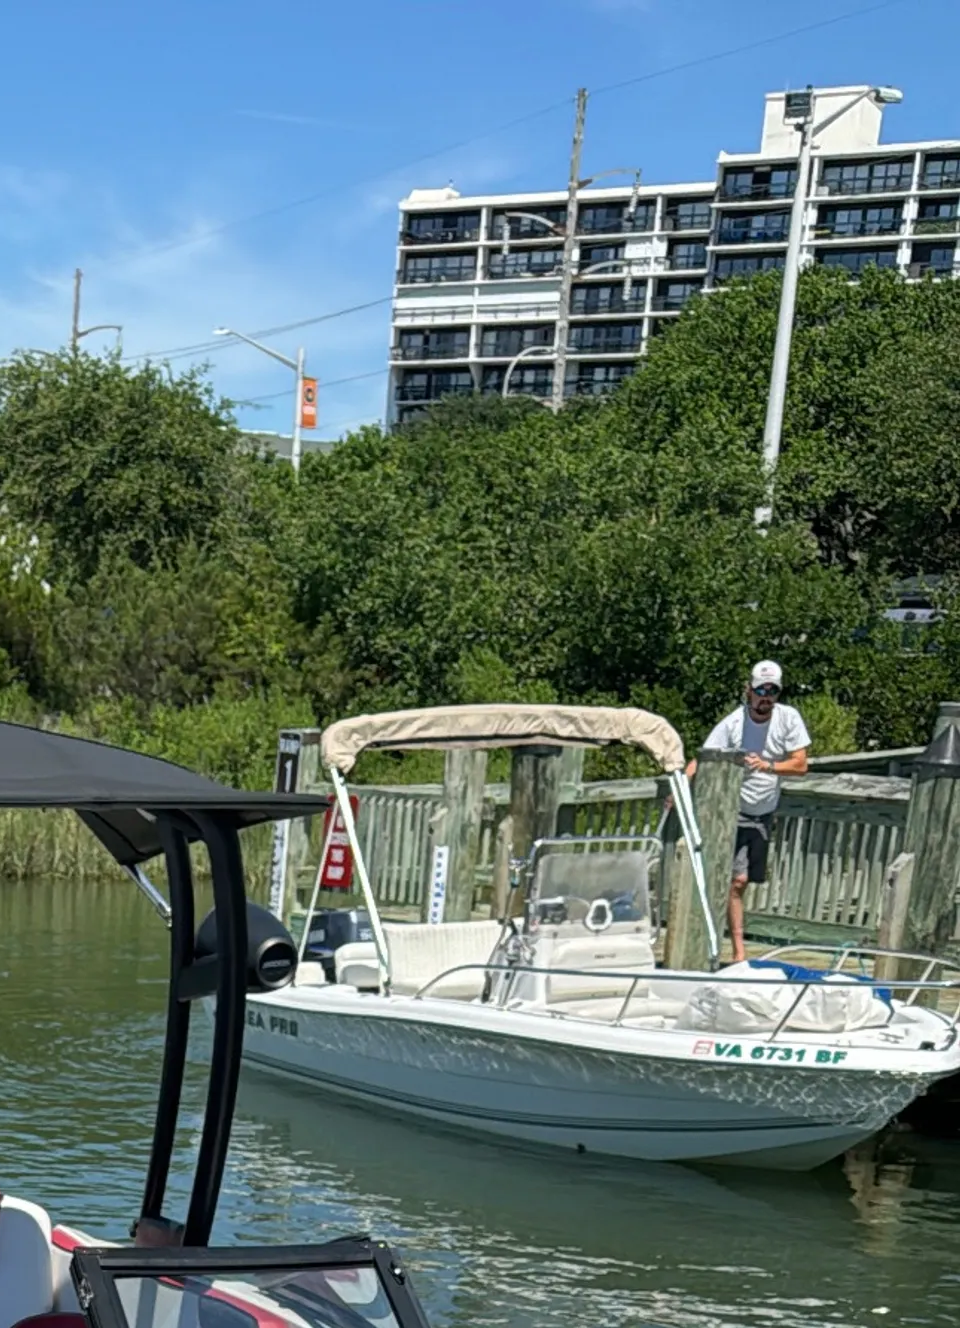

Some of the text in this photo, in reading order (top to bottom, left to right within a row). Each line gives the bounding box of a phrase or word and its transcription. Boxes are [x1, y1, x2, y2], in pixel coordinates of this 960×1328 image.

[247, 1009, 266, 1030] EA
[714, 1042, 848, 1065] VA 6731 BF
